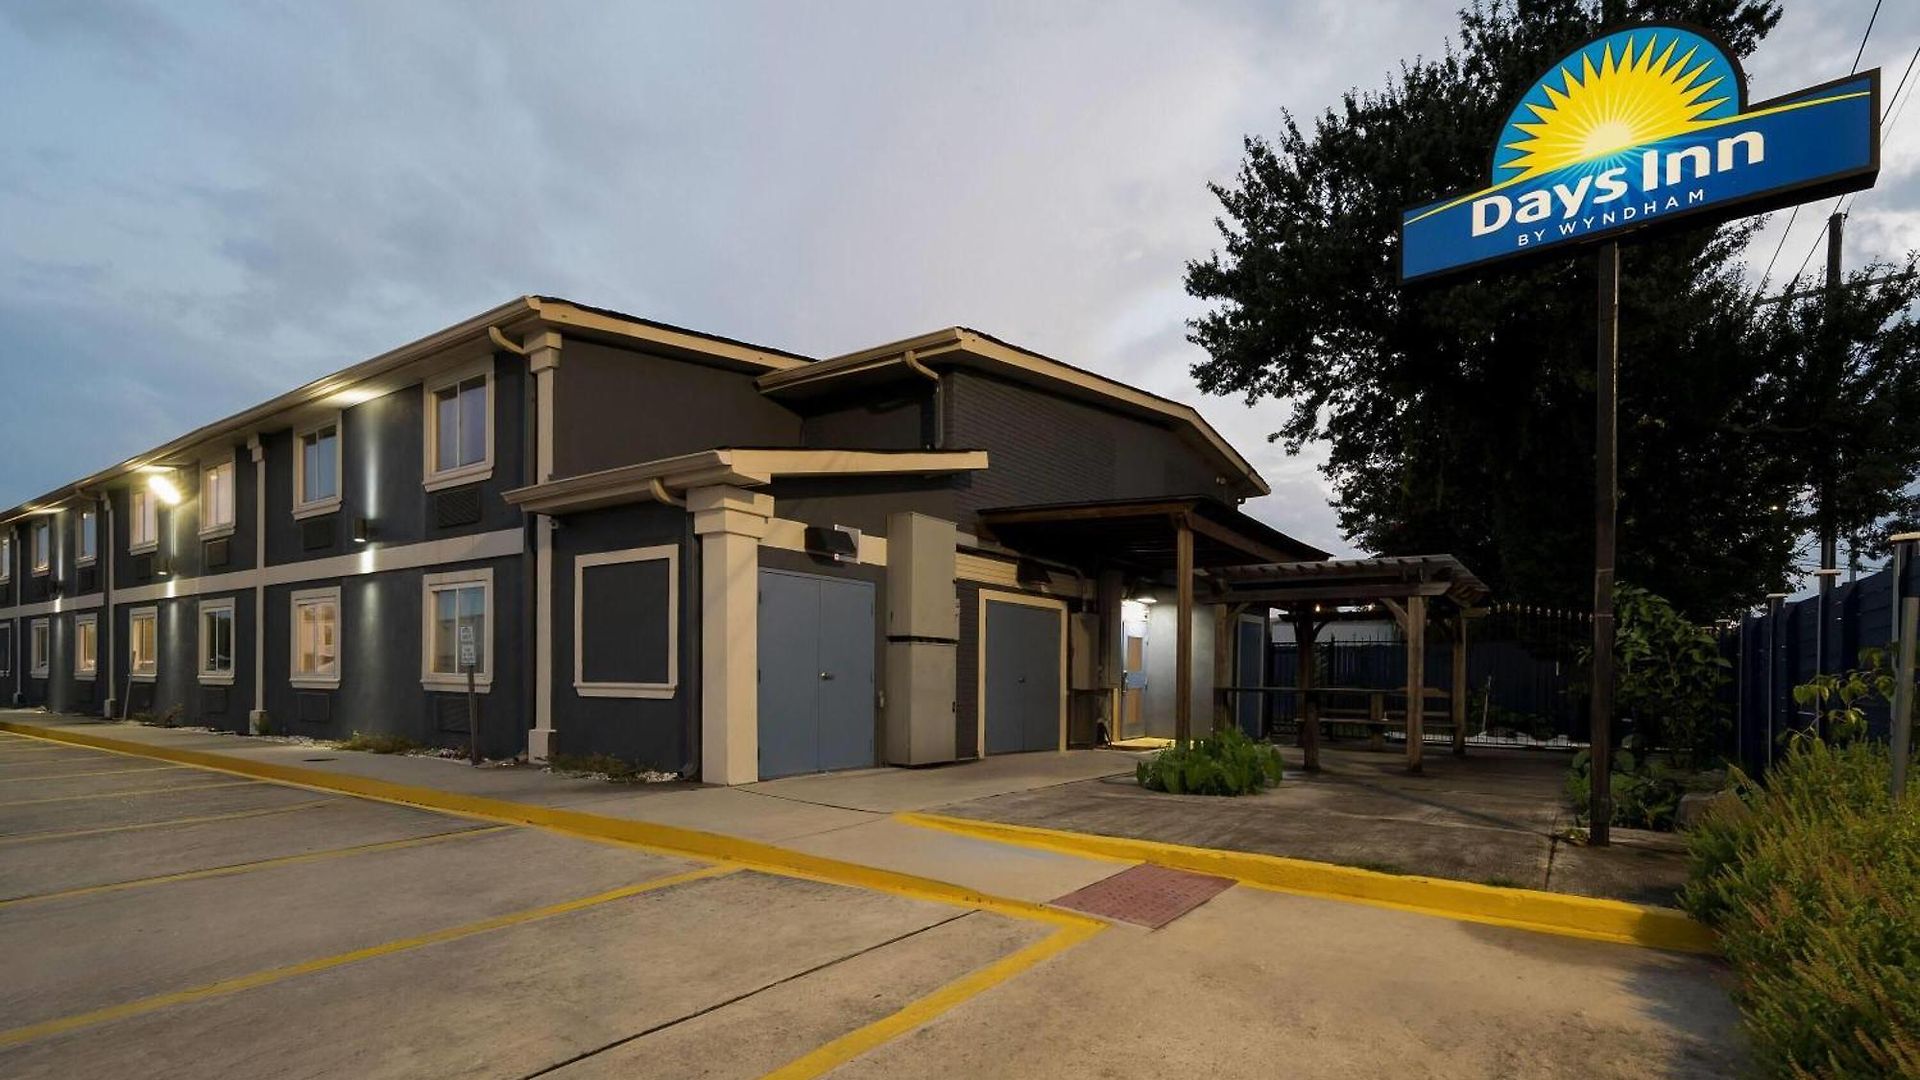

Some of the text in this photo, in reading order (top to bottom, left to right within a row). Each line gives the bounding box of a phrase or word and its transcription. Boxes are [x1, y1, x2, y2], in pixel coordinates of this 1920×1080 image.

[1471, 130, 1765, 237] Days Inn
[1518, 188, 1704, 247] BY WYNDHAM
